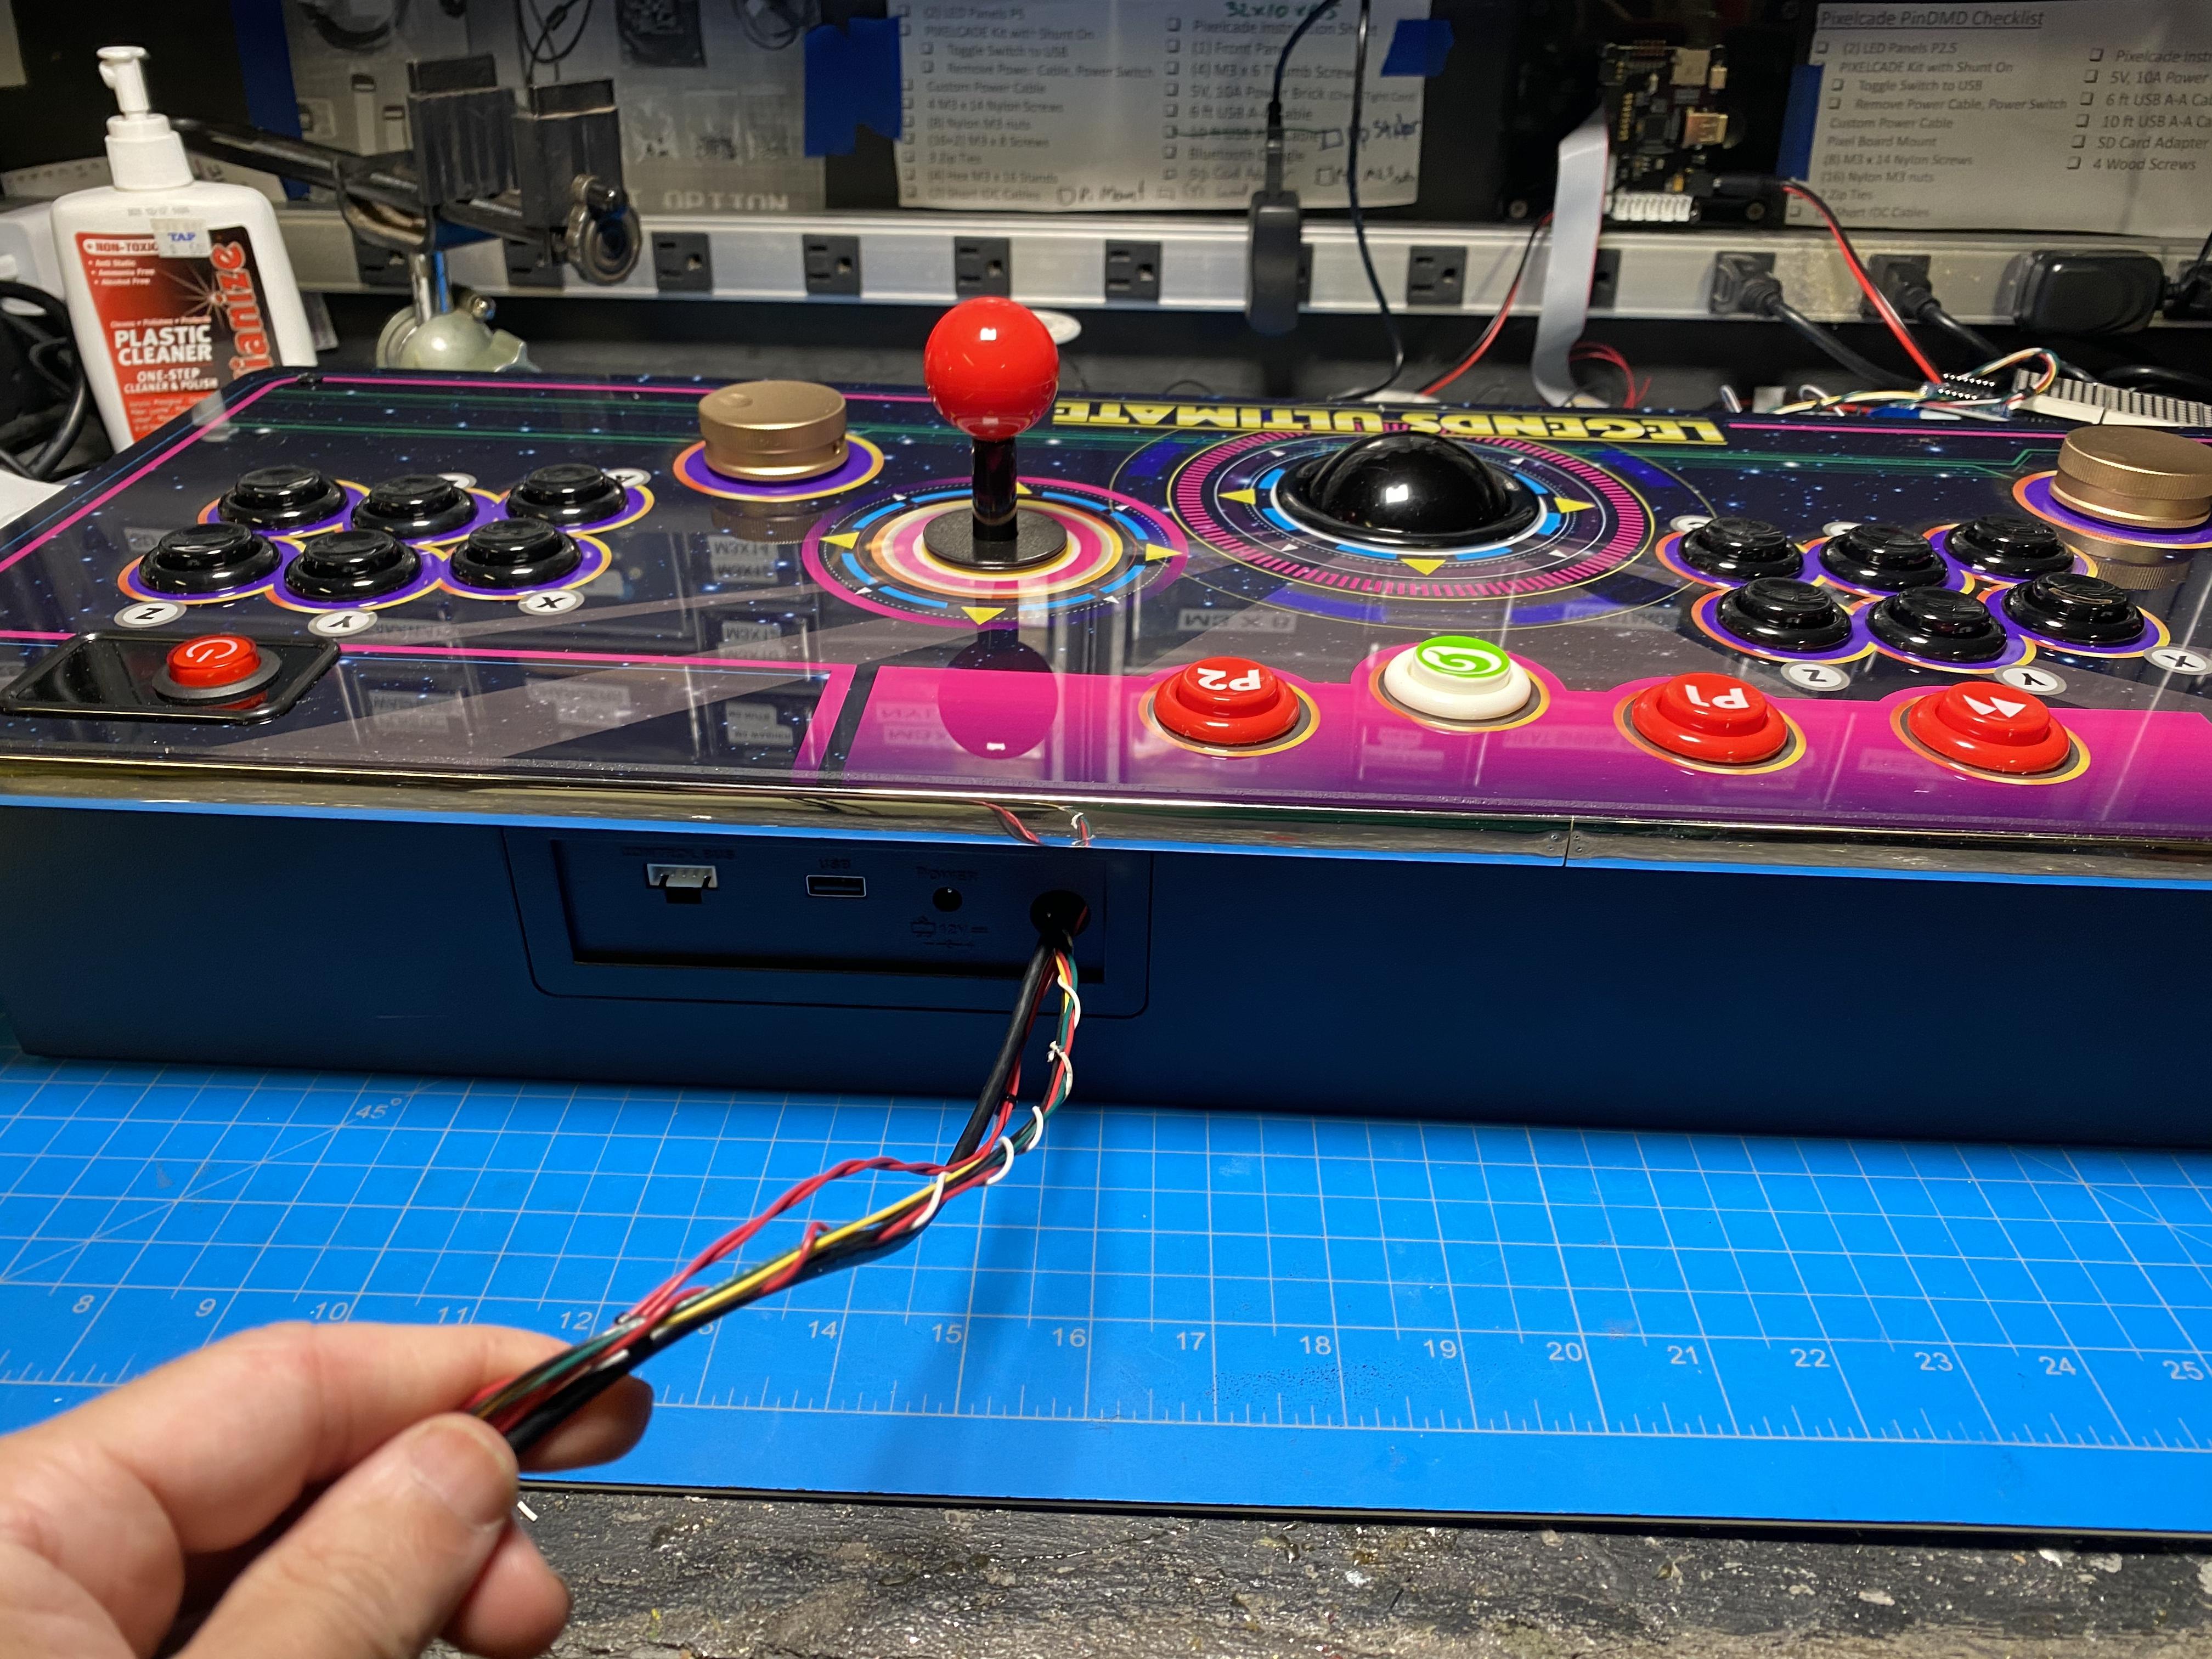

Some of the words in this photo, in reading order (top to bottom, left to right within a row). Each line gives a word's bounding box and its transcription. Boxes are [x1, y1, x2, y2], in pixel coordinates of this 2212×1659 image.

[1821, 11, 1897, 26] Pixelcade
[1900, 11, 1968, 25] PinDMD
[1974, 11, 2044, 26] Checklist
[1843, 43, 1860, 55] (2)
[1863, 43, 1885, 53] LED
[1888, 42, 1927, 54] Panels
[2116, 49, 2181, 63] Pixelcade
[1839, 61, 1904, 72] PIXELCADE
[1908, 61, 1925, 72] Kit
[1927, 61, 1954, 72] with
[1956, 62, 1993, 73] Shunt
[1996, 62, 2013, 73] On
[2110, 71, 2130, 85] 5V,
[2136, 71, 2160, 83] 10A
[2166, 71, 2209, 84] Power
[1859, 80, 1897, 93] Toggle
[1900, 80, 1939, 91] Switch
[1943, 82, 1955, 91] to
[1958, 80, 1983, 91] USB
[1855, 98, 1903, 109] Remove
[1908, 99, 1945, 109] Power
[1989, 98, 2026, 109] Power
[2029, 98, 2068, 109] Switch
[2106, 93, 2114, 106] 6
[2134, 93, 2160, 106] USB
[2165, 93, 2187, 106] A-A
[1829, 117, 1875, 128] Custom
[1878, 117, 1915, 128] Power
[1920, 117, 1953, 129] Cable
[2102, 115, 2120, 128] 10
[2138, 115, 2165, 128] USB
[2168, 116, 2193, 128] A-A
[1858, 136, 1893, 147] Board
[1897, 136, 1937, 146] Mount
[2098, 137, 2116, 149] SD
[2120, 136, 2151, 149] Card
[2154, 136, 2209, 151] Adapter
[1932, 154, 1973, 165] Screws
[2094, 158, 2101, 169] 4
[2107, 157, 2146, 170] Wood
[2148, 157, 2196, 170] Screws
[137, 268, 156, 276] Free
[132, 278, 151, 286] Free
[209, 241, 273, 379] ianize
[114, 324, 212, 349] PLASTIC
[117, 343, 213, 366] CLEANER
[136, 367, 201, 383] ONE-STEP
[123, 381, 169, 394] CLEANER
[170, 380, 179, 392] &
[180, 377, 219, 391] POLISH
[1053, 402, 1383, 432] ULTIMATE
[1401, 413, 1726, 443] LEGENDS
[535, 596, 568, 609] X
[135, 608, 165, 620] Z
[328, 616, 353, 628] Y
[2160, 654, 2199, 668] X
[1197, 667, 1261, 691] P2
[1802, 669, 1827, 682] Z
[2021, 673, 2048, 686] Y
[1685, 684, 1750, 709] P1
[818, 858, 851, 869] USB
[916, 866, 978, 882] POWER
[354, 1097, 402, 1119] 45°
[72, 1295, 94, 1313] 8
[195, 1299, 216, 1317] 9
[315, 1302, 348, 1321] 10
[438, 1307, 468, 1324] 11
[560, 1312, 592, 1330] 12
[809, 1321, 837, 1339] 14
[932, 1323, 962, 1344] 15
[1053, 1328, 1086, 1348] 16
[1176, 1331, 1205, 1351] 17
[1300, 1335, 1331, 1355] 18
[1424, 1339, 1457, 1359] 19
[1547, 1341, 1582, 1362] 20
[1668, 1346, 1698, 1365] 21
[1791, 1348, 1830, 1367] 22
[1915, 1352, 1953, 1372] 23
[2039, 1356, 2076, 1375] 24
[2162, 1360, 2204, 1381] 25
